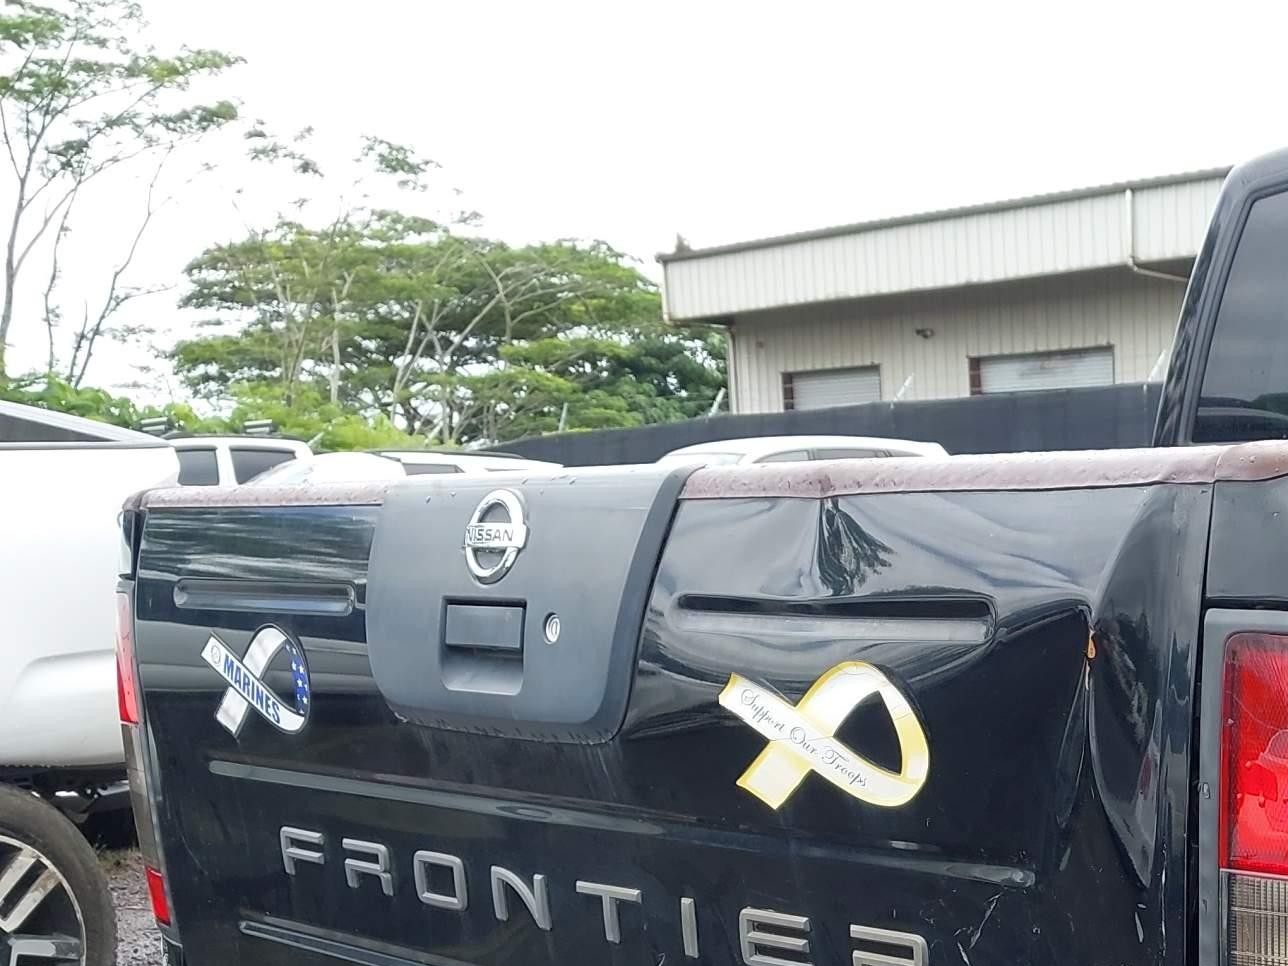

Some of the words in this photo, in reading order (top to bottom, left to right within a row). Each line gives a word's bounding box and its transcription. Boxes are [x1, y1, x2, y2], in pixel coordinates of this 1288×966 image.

[466, 526, 514, 544] NISSAN
[224, 653, 281, 725] MARINES
[740, 688, 786, 733] Support
[789, 726, 818, 755] Our
[821, 745, 868, 788] Troops
